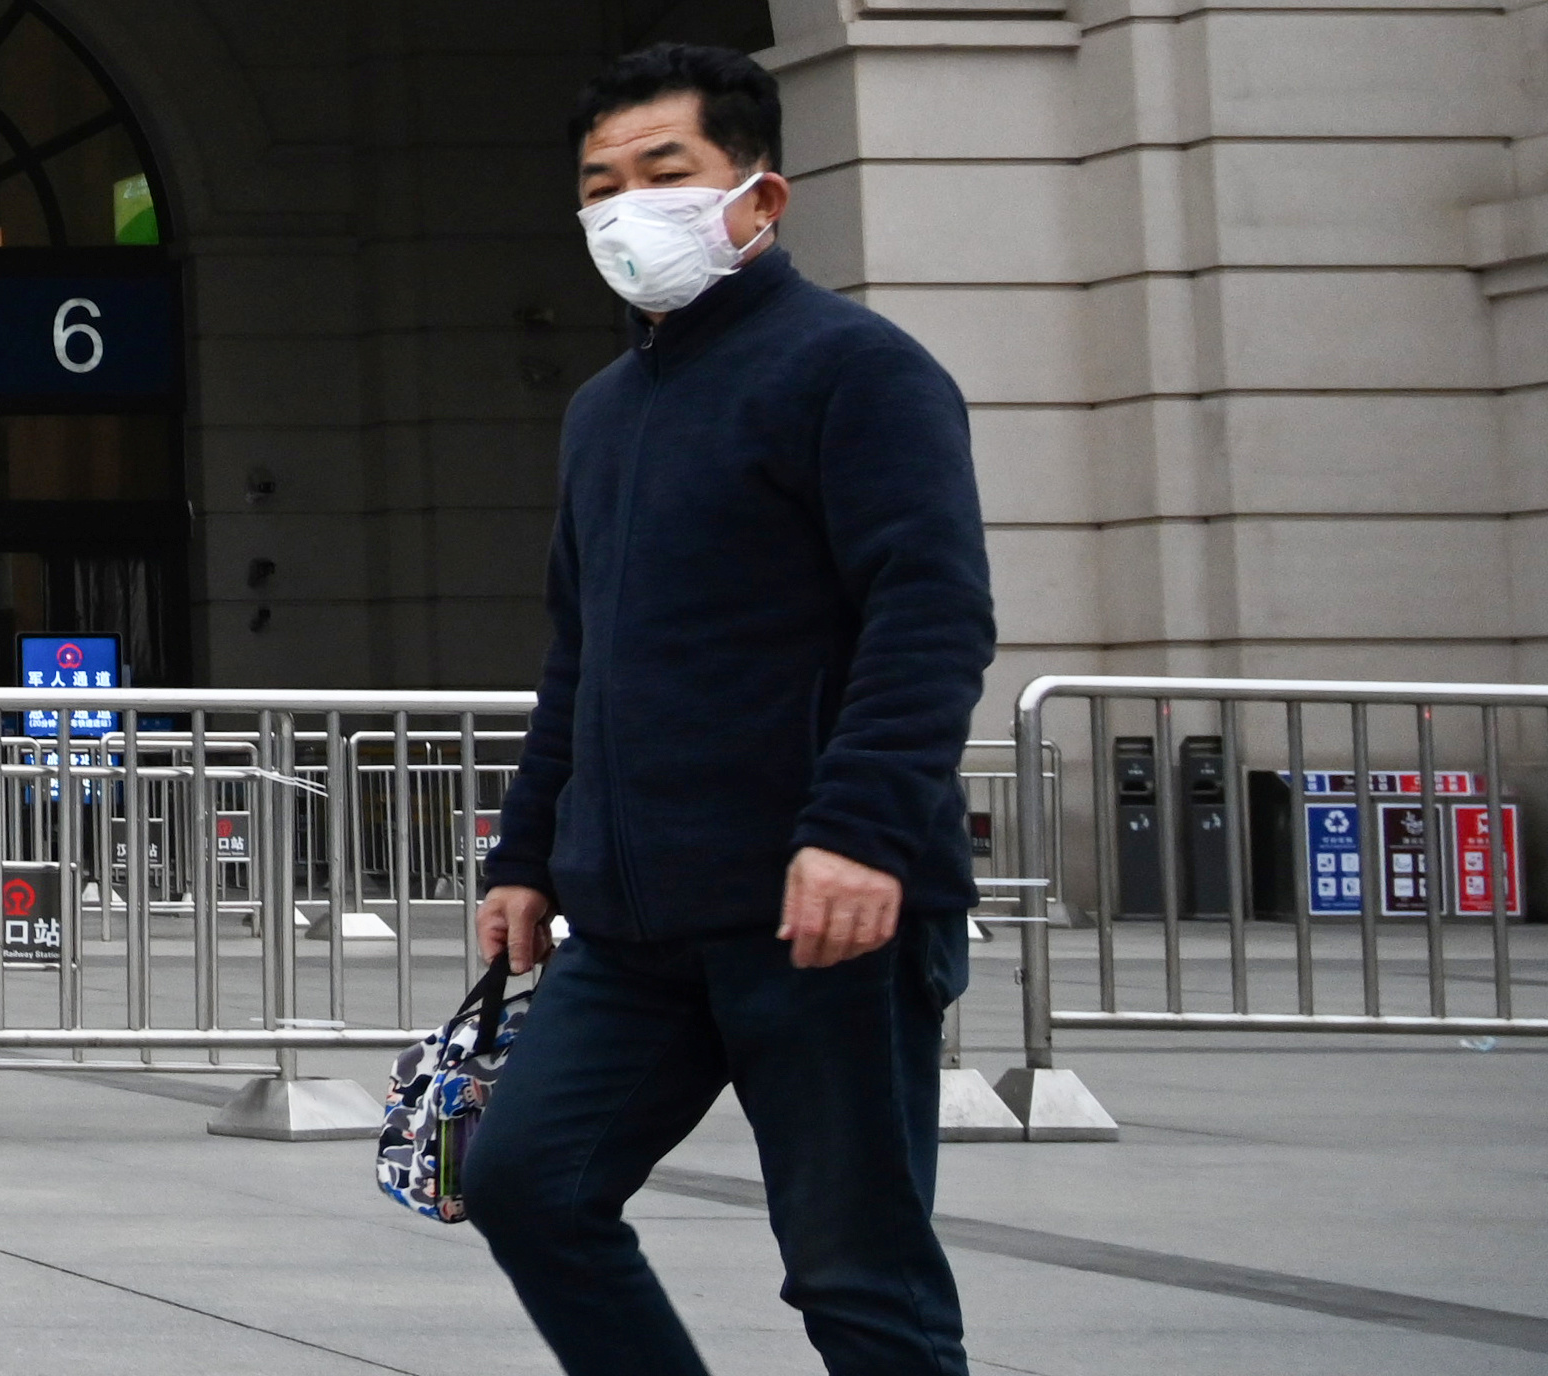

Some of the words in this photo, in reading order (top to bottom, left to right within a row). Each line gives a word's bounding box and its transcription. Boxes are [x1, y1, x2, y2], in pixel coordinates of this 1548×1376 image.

[53, 297, 104, 374] 6
[27, 671, 112, 687] 军人通道
